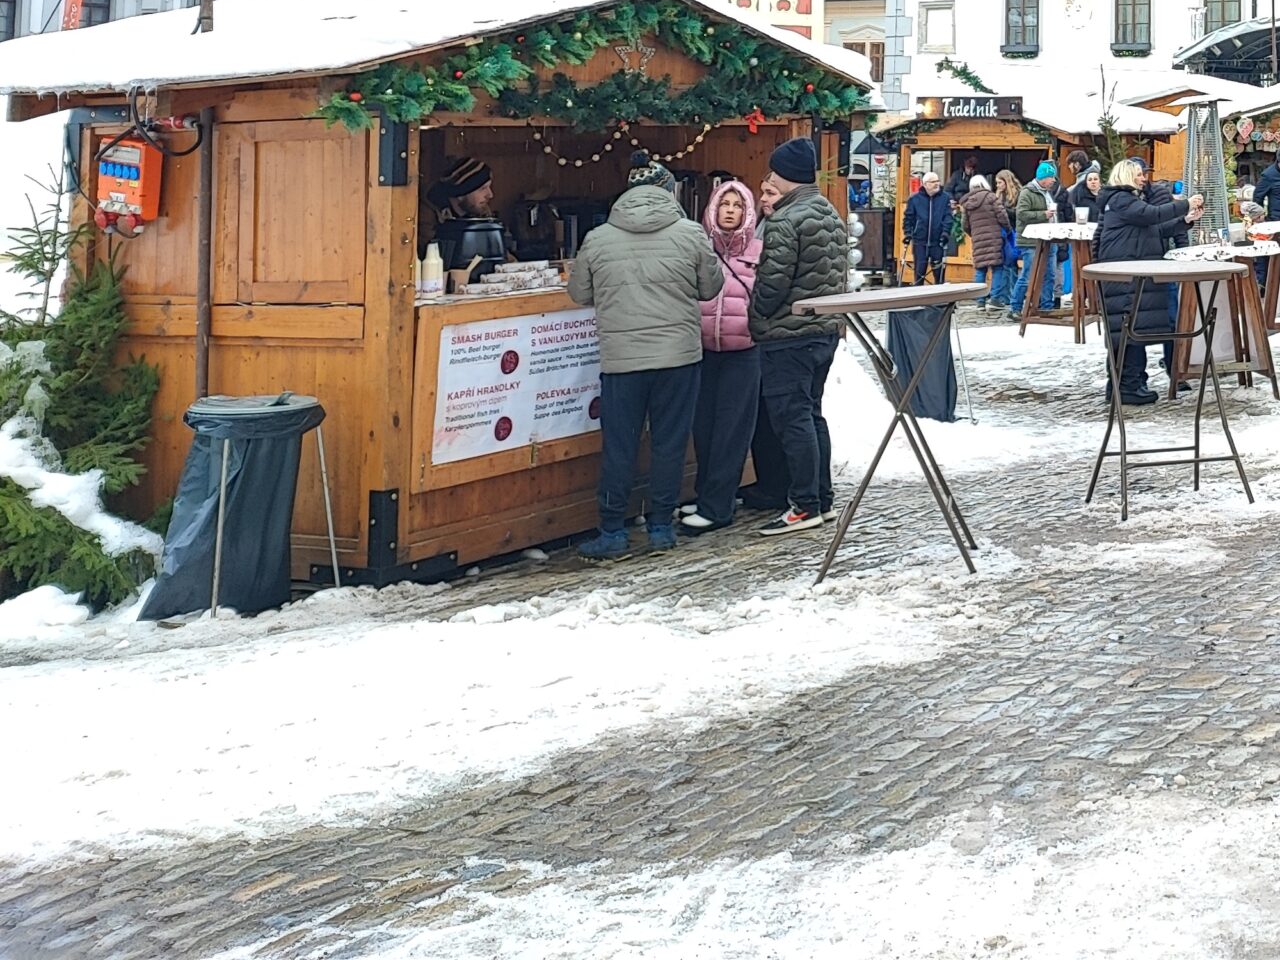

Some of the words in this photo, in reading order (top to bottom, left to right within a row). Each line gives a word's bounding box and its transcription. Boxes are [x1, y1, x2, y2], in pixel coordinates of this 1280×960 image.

[942, 97, 998, 117] Trdelník
[531, 321, 563, 334] DOMÁCÍ
[451, 333, 482, 345] SMASH
[484, 329, 519, 340] BURGER
[531, 338, 537, 347] S
[451, 348, 467, 356] 100%
[468, 345, 482, 353] Beef
[482, 343, 501, 352] burger
[447, 386, 475, 401] KAPŘÍ
[477, 380, 521, 395] HRANOLKY
[445, 411, 476, 423] Traditional
